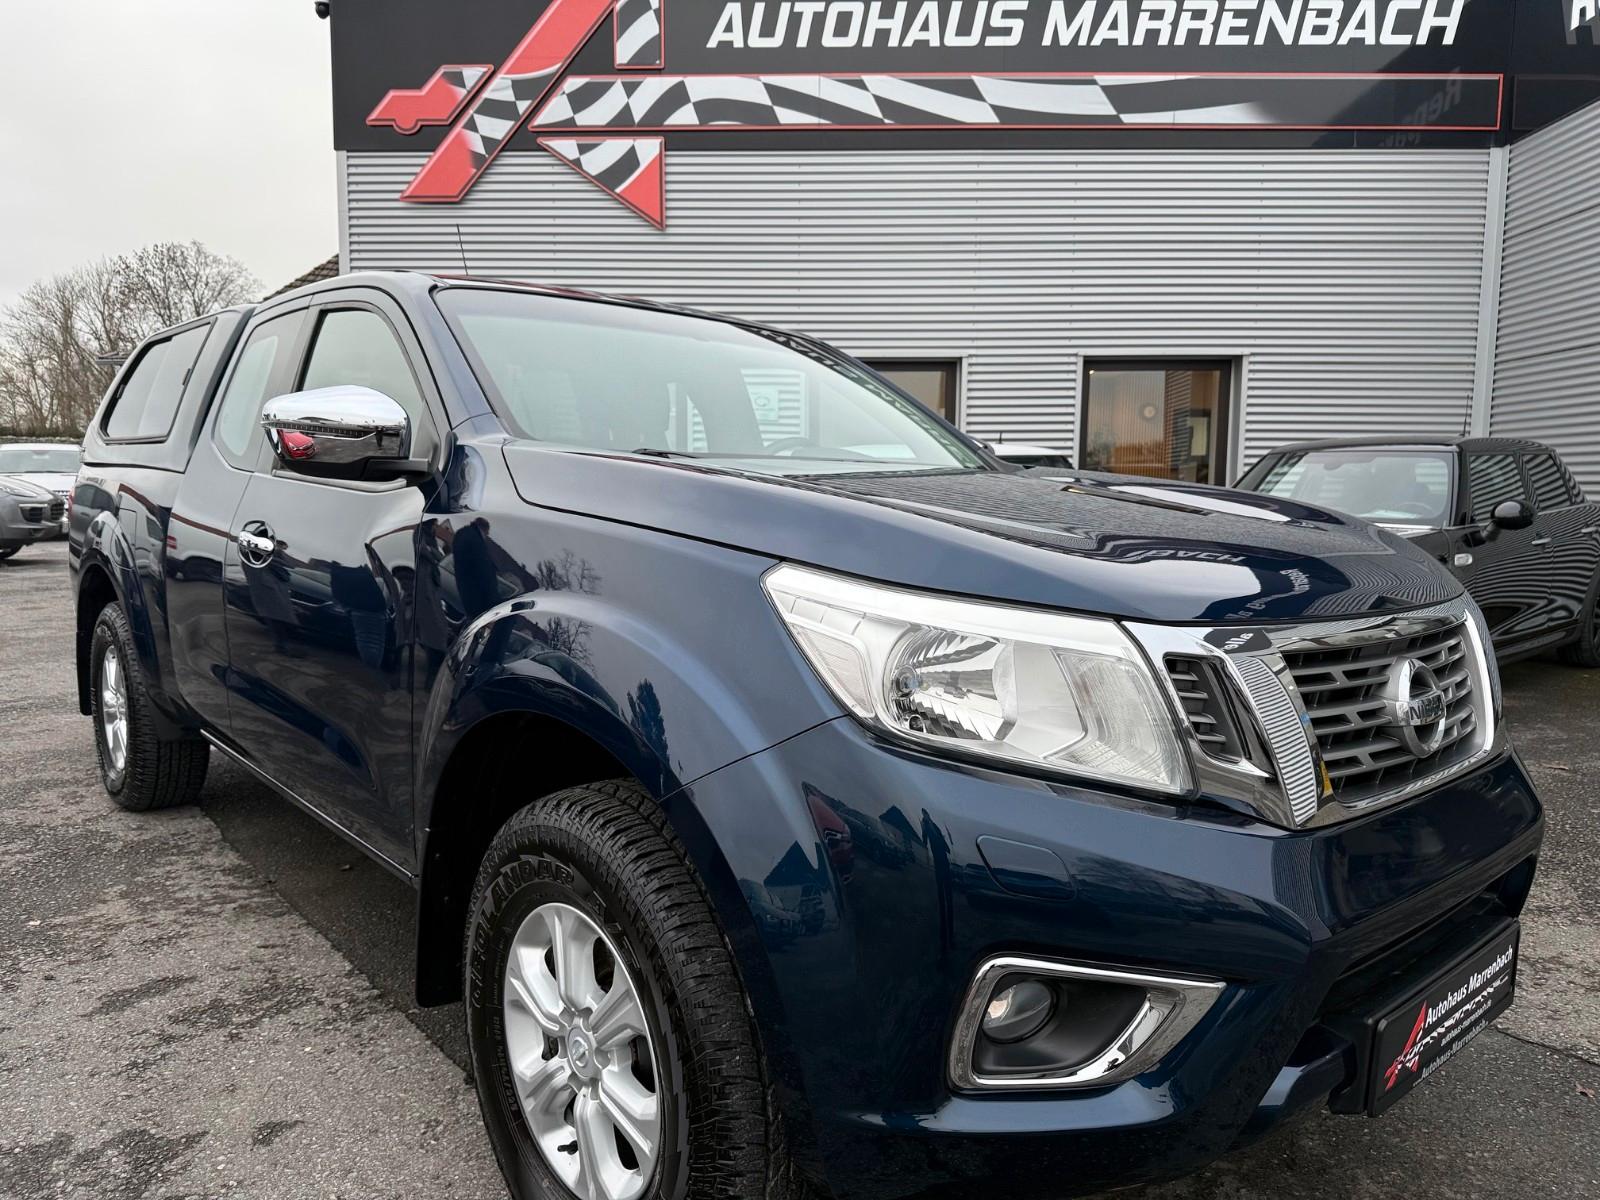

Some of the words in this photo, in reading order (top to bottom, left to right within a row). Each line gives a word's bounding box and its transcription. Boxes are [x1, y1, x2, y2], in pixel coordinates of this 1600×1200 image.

[706, 0, 1028, 49] AUTOHAUS
[1041, 0, 1463, 47] MARRENBACH
[1425, 983, 1468, 1029] Autohaus
[1468, 944, 1513, 994] Marrenbach
